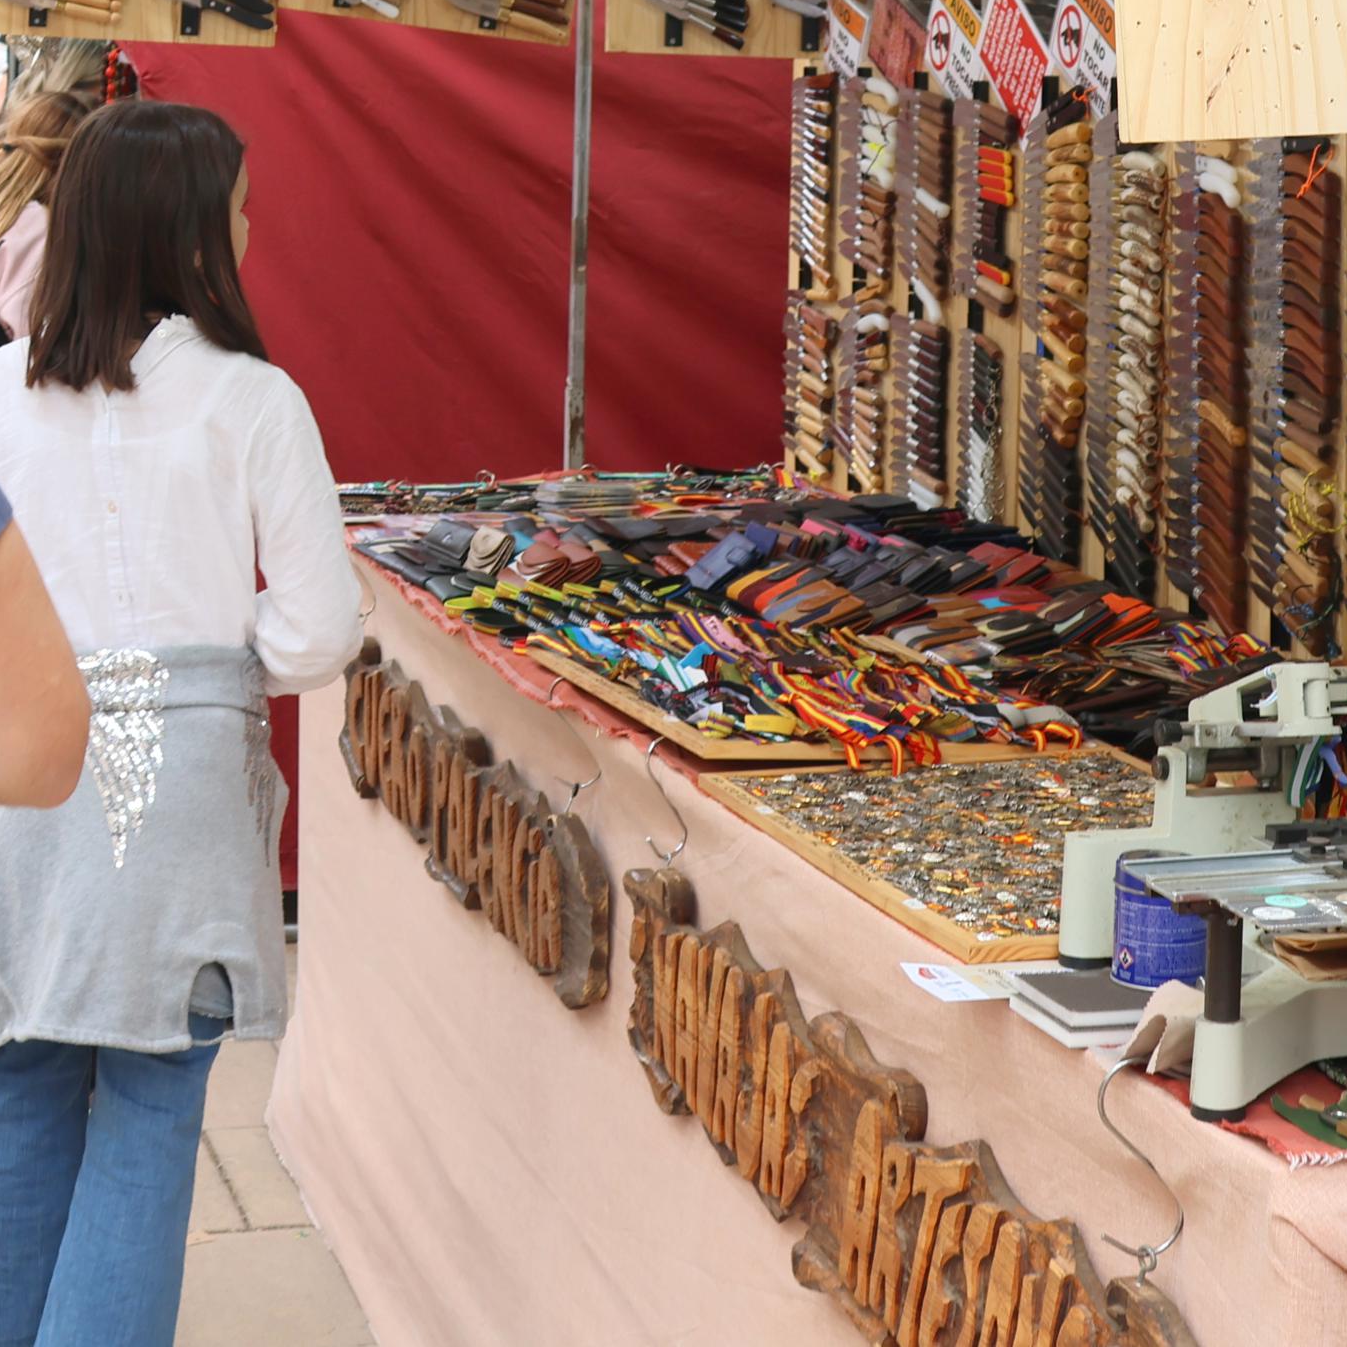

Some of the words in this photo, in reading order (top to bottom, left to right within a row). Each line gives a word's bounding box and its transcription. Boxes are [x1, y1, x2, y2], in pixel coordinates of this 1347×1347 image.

[960, 42, 972, 64] NO
[1093, 39, 1106, 61] NO
[1083, 52, 1109, 92] TOCAR
[351, 670, 430, 830] CUERO
[653, 932, 821, 1209] NAVAJAS
